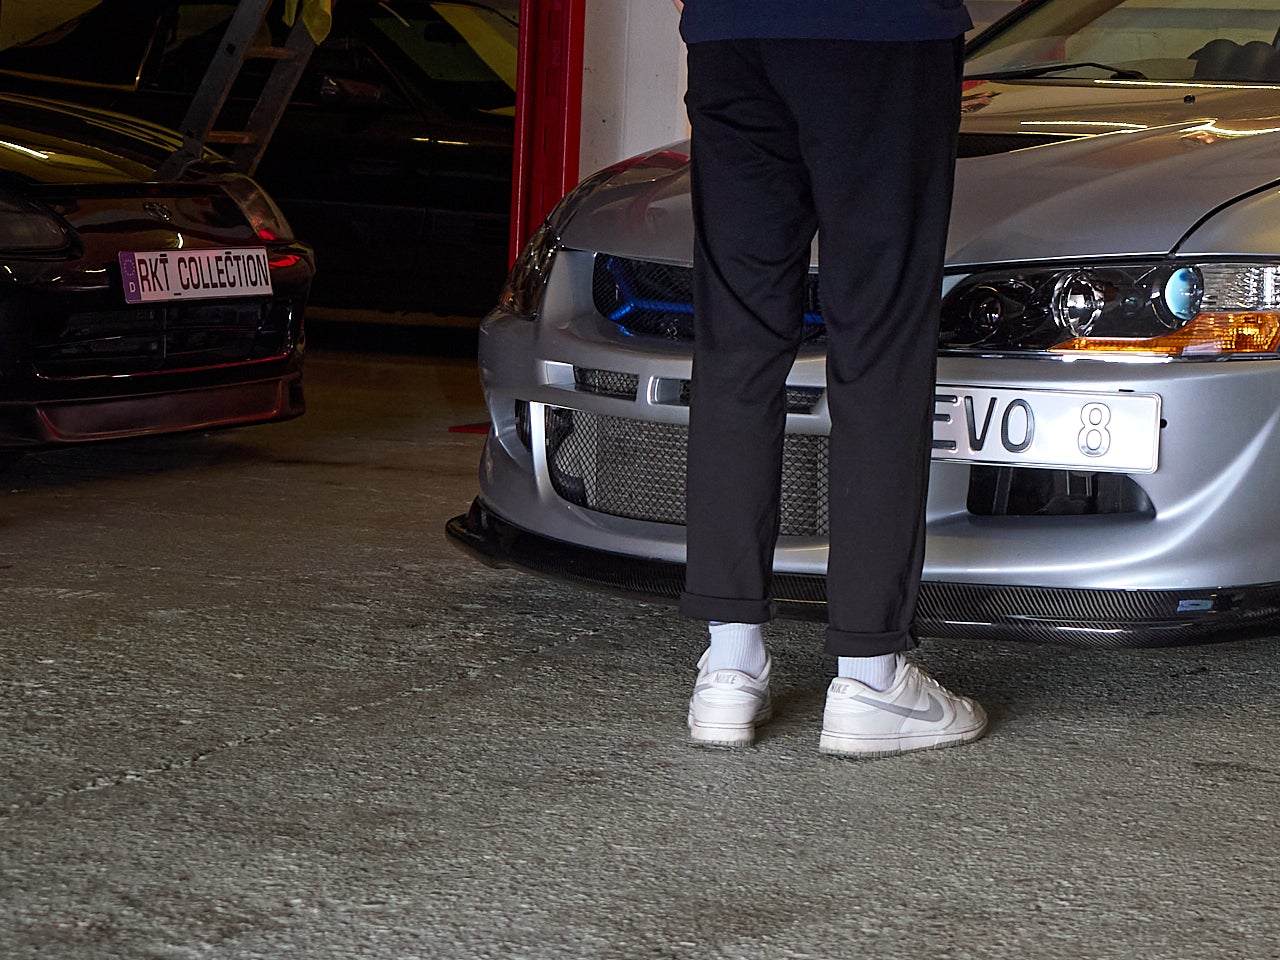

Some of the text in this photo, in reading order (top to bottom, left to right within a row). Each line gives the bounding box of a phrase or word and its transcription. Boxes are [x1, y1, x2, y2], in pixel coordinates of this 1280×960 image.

[931, 394, 1112, 458] EVO 8
[713, 673, 739, 686] NIKE
[831, 683, 850, 696] NIKE
